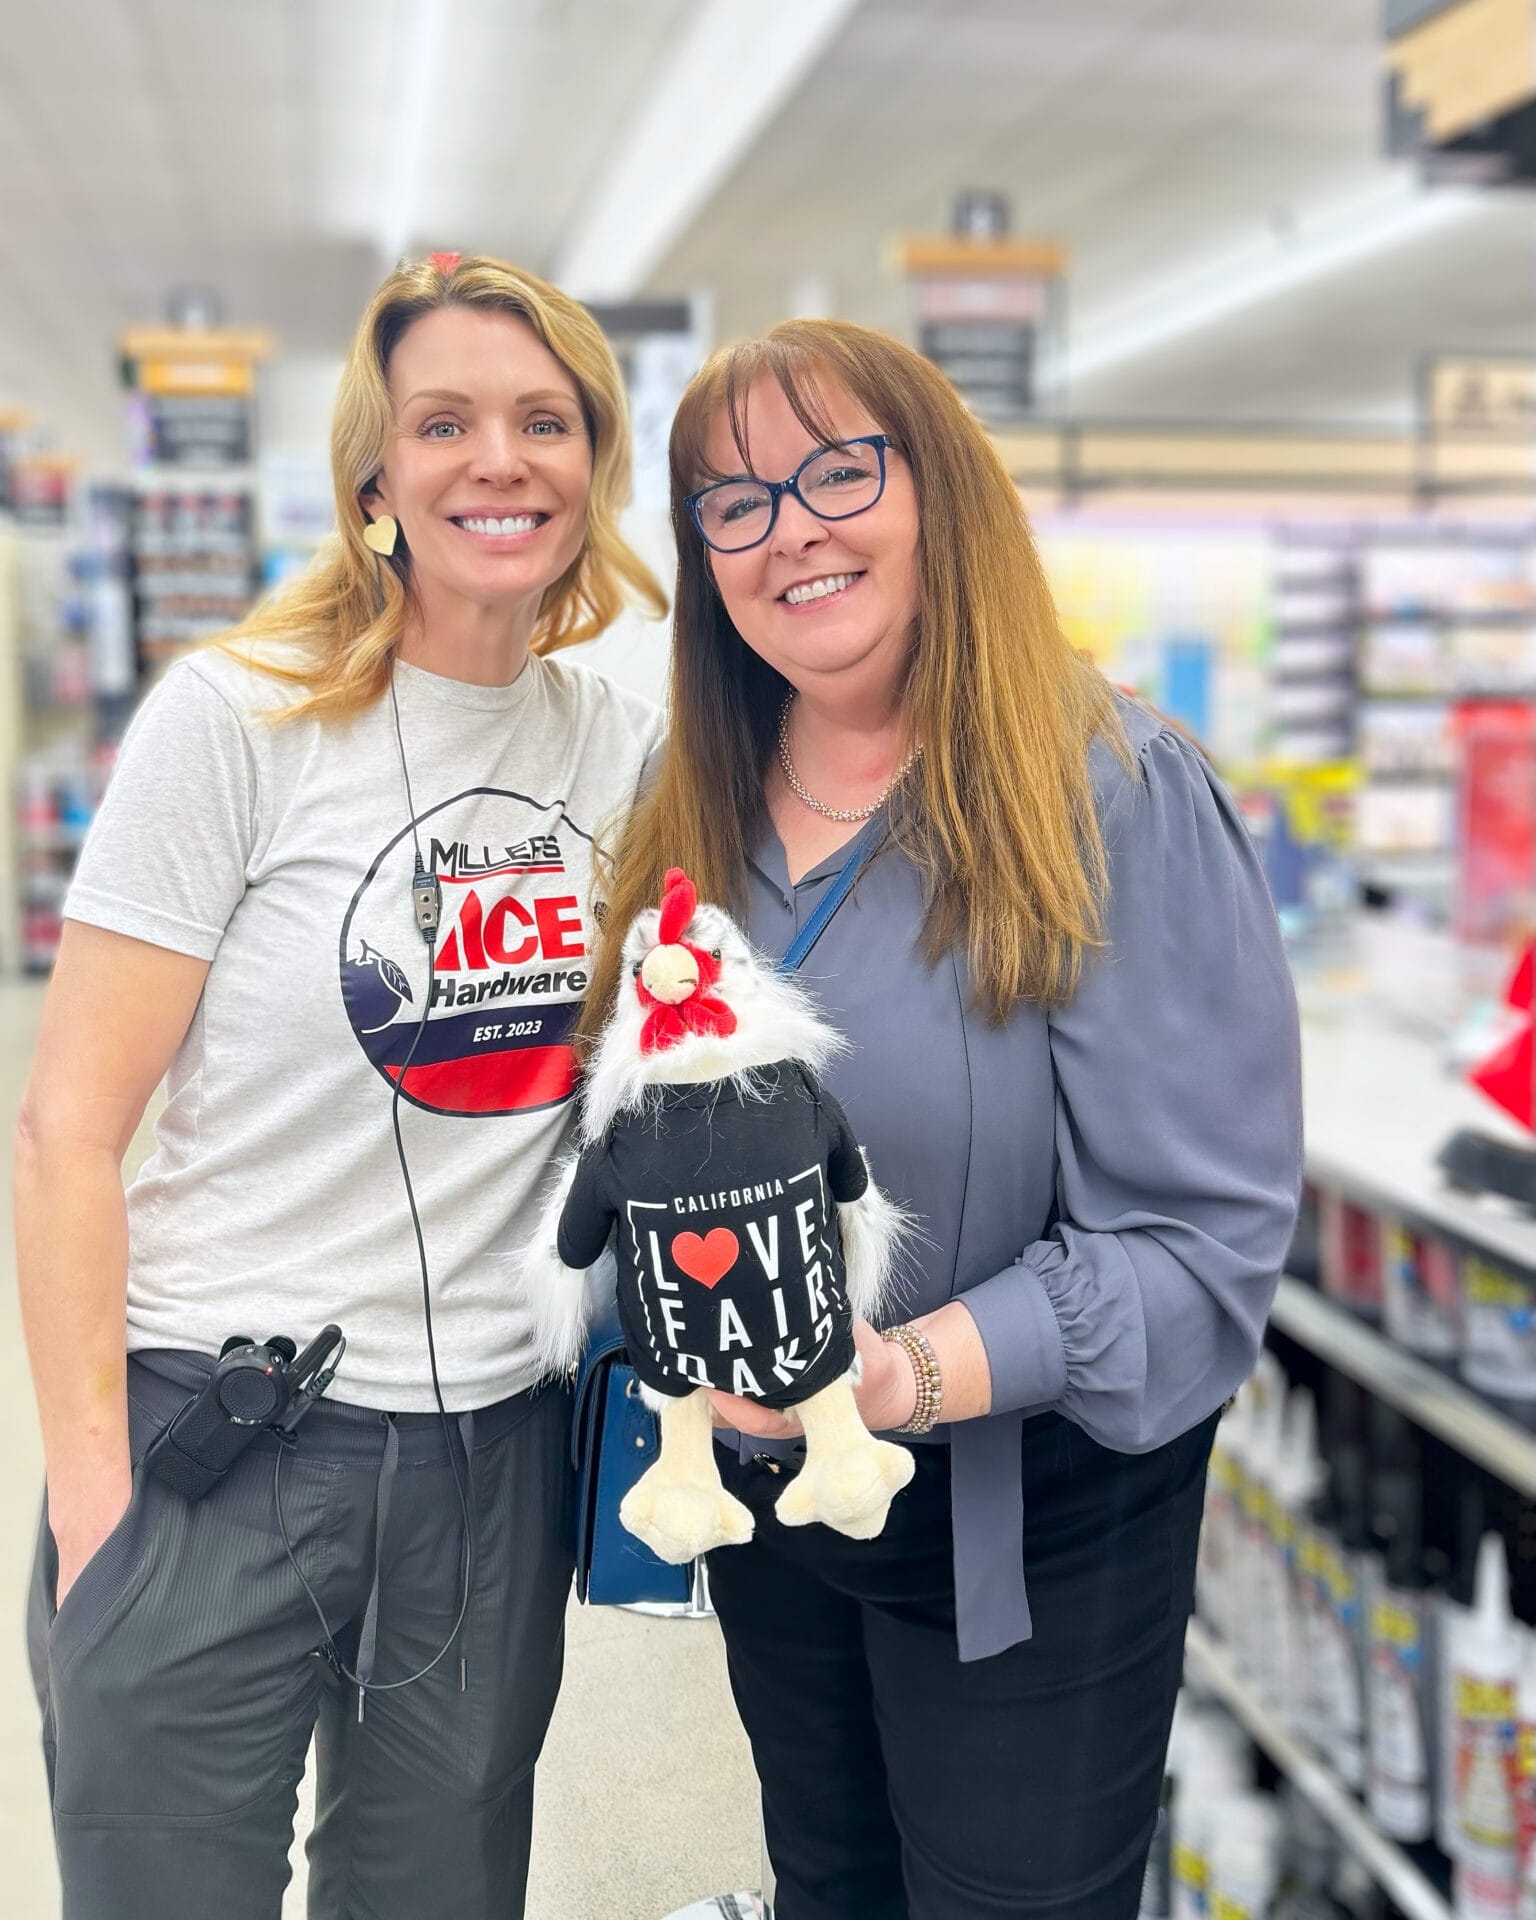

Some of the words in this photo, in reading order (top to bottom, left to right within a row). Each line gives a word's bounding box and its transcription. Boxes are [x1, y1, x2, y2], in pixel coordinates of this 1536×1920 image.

[433, 889, 586, 971] ACE
[430, 969, 588, 1008] Hardware
[472, 1023, 502, 1043] EST.
[505, 1020, 543, 1038] 2023
[674, 1178, 785, 1214] CALIFORNIA
[659, 1260, 829, 1351] FAIR
